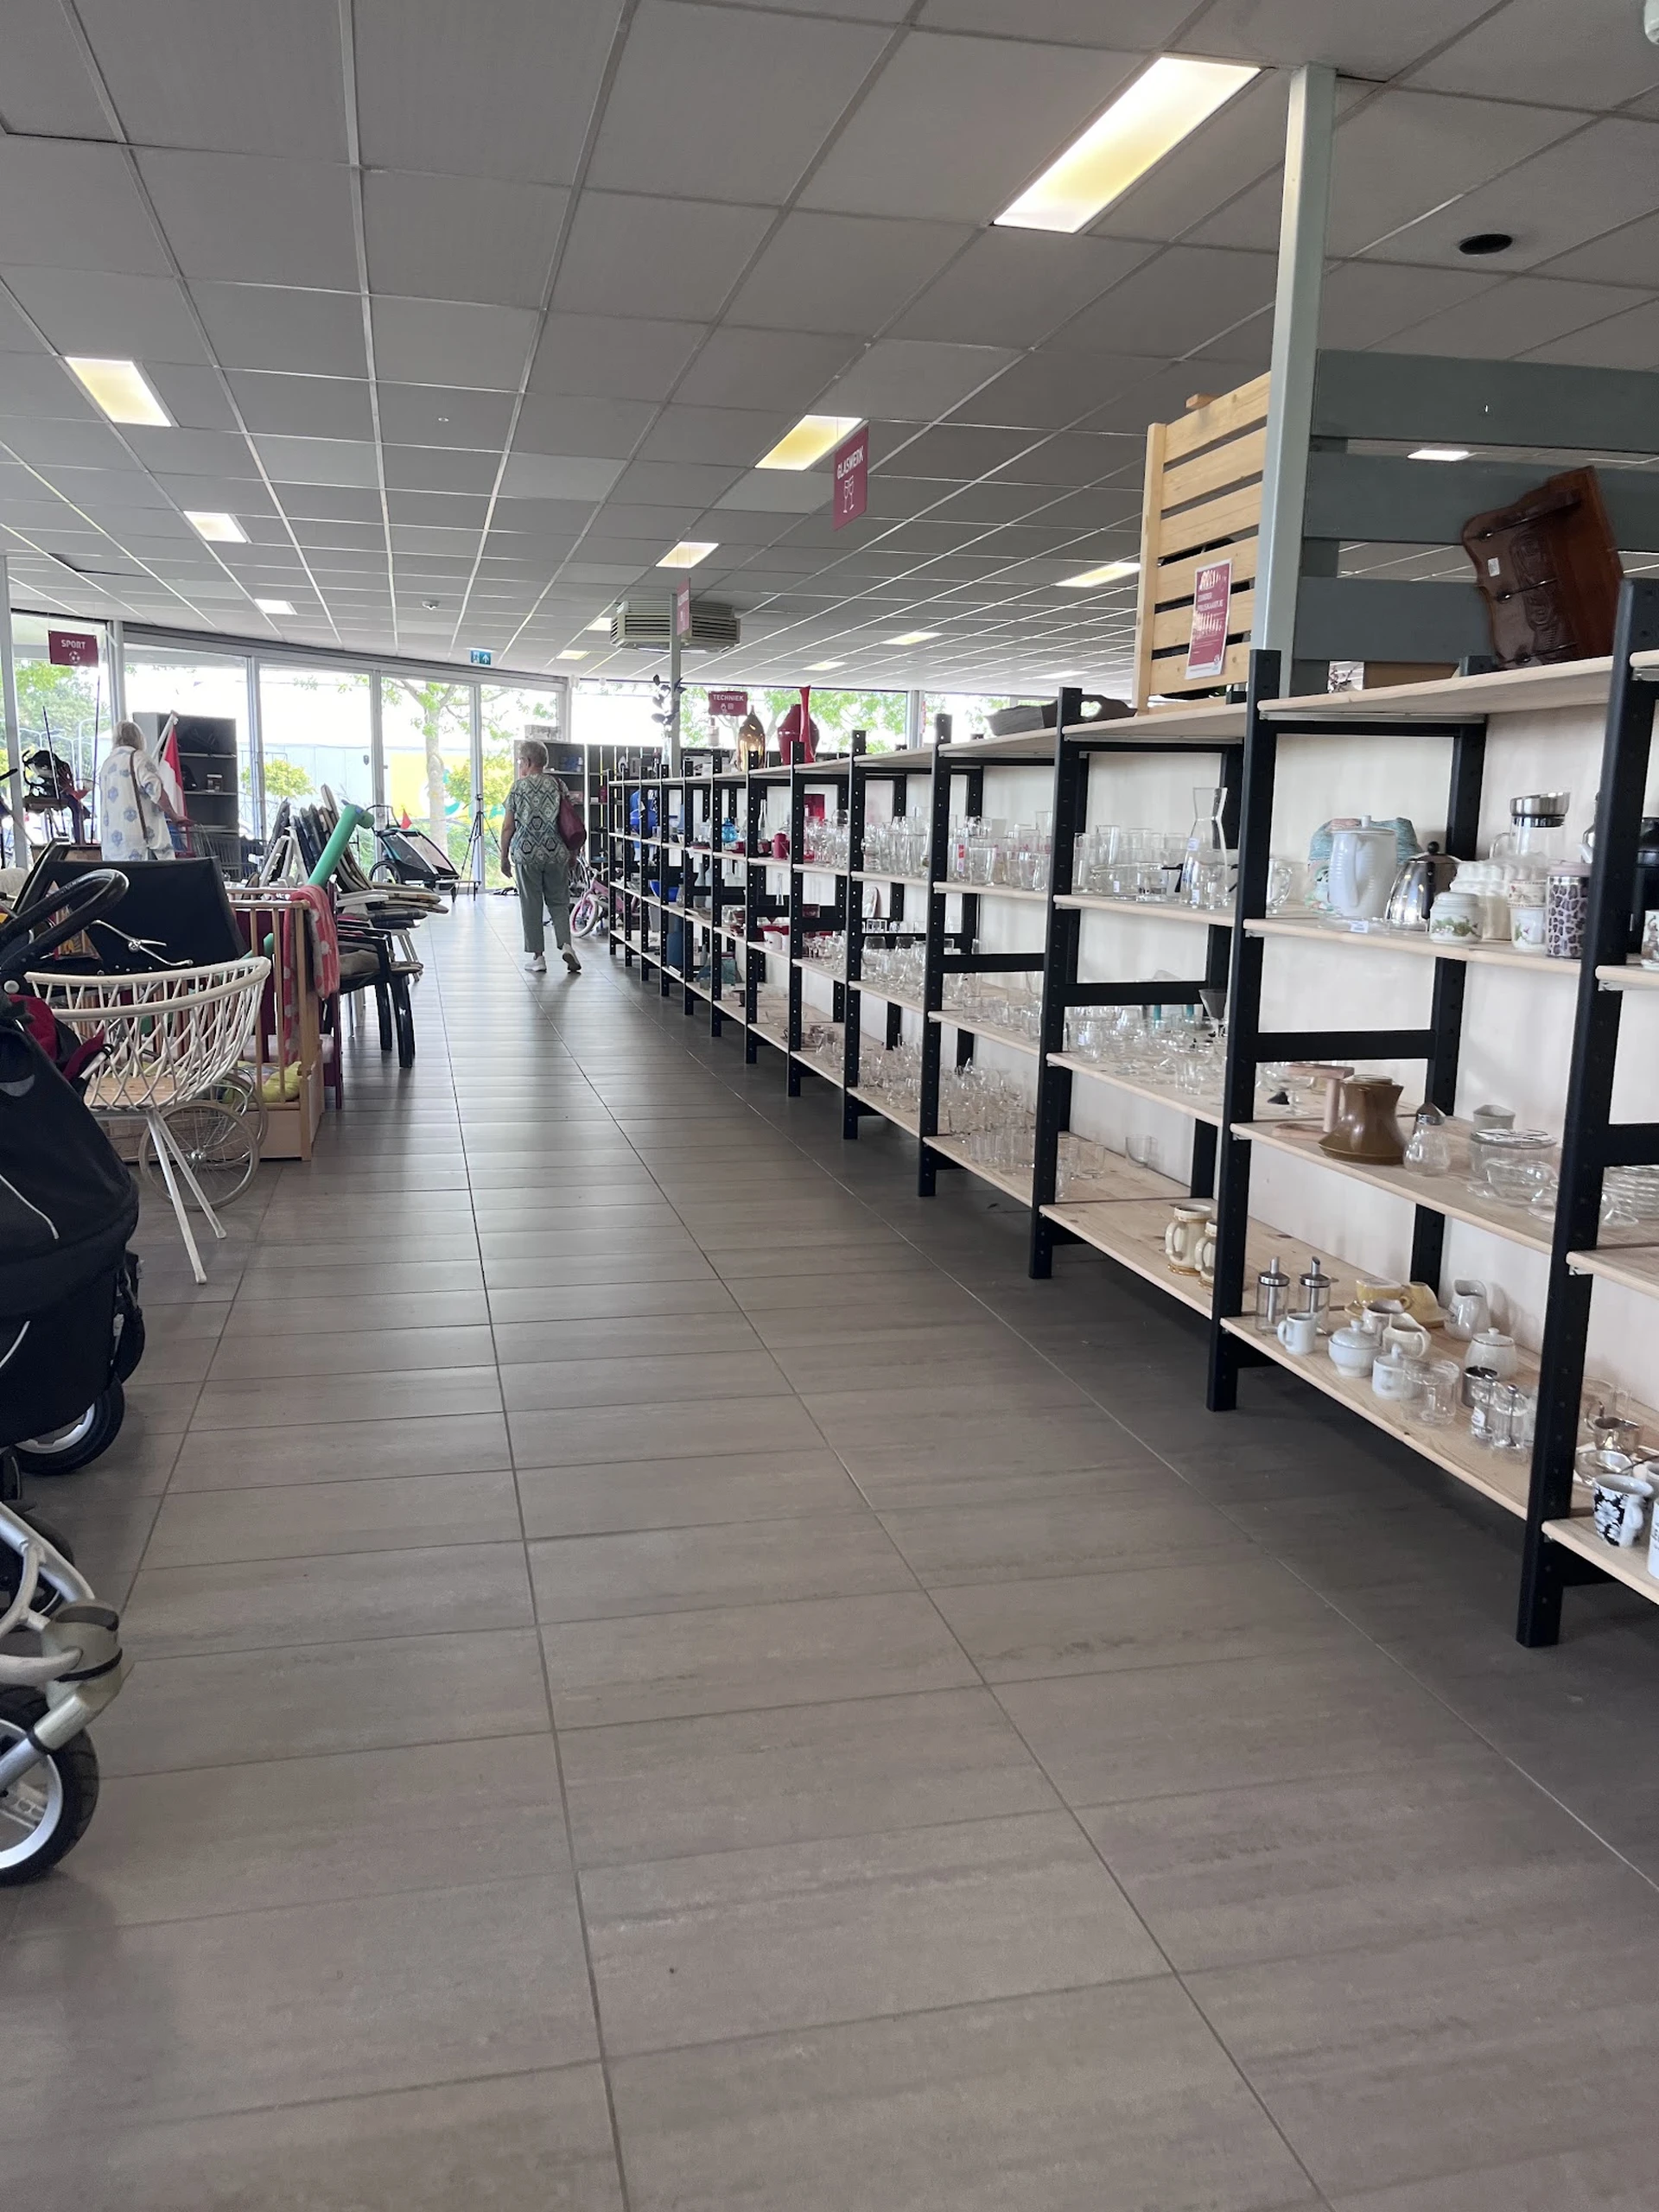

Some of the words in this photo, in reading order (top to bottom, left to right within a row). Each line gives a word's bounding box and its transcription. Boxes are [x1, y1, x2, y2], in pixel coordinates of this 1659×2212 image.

[836, 445, 864, 480] GLASWERK
[60, 639, 86, 650] SPORT
[712, 694, 745, 702] TECHNIEK
